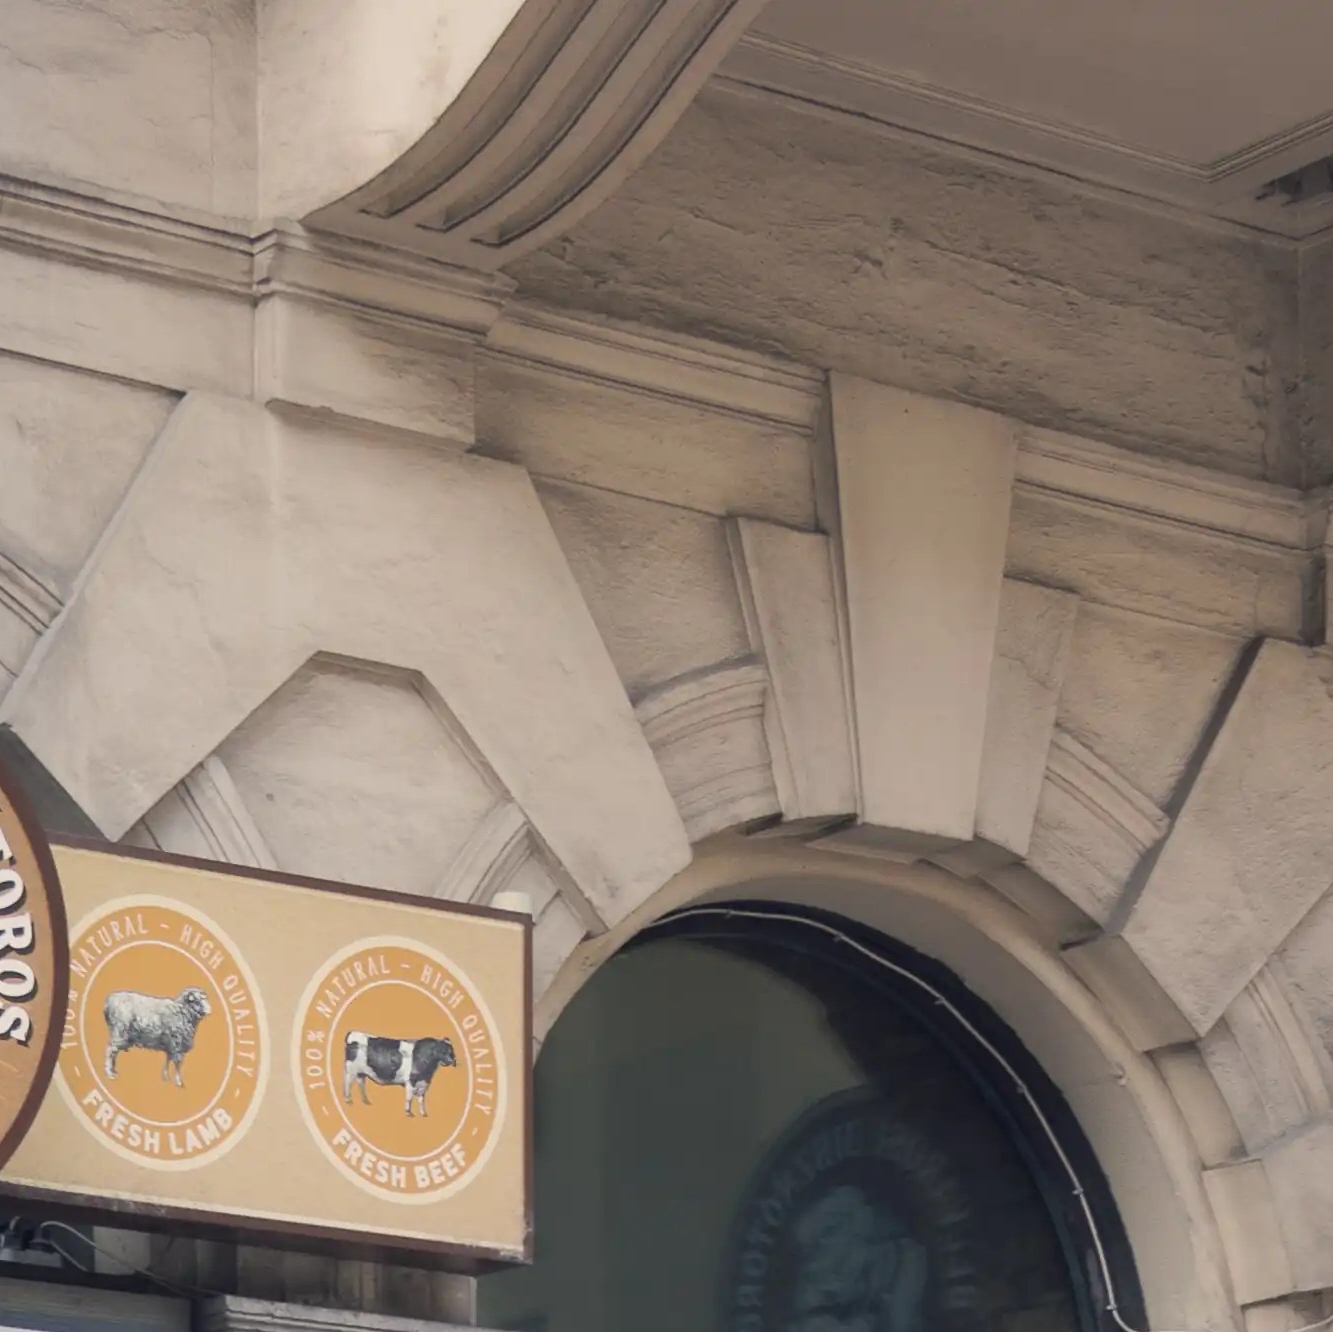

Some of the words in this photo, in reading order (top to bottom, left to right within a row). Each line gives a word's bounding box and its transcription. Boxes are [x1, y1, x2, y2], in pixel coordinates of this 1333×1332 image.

[69, 913, 149, 978] NATURAL
[180, 924, 224, 970] HIGH
[223, 976, 255, 1079] QUALITY
[316, 955, 391, 1018] NATURAL
[419, 964, 465, 1008] HIGH
[306, 1030, 330, 1090] 100%
[462, 1014, 493, 1115] QUALITY
[83, 1090, 161, 1154] FRESH
[168, 1108, 234, 1155] LAMB
[333, 1131, 408, 1189] FRESH
[413, 1145, 467, 1190] BEEF
